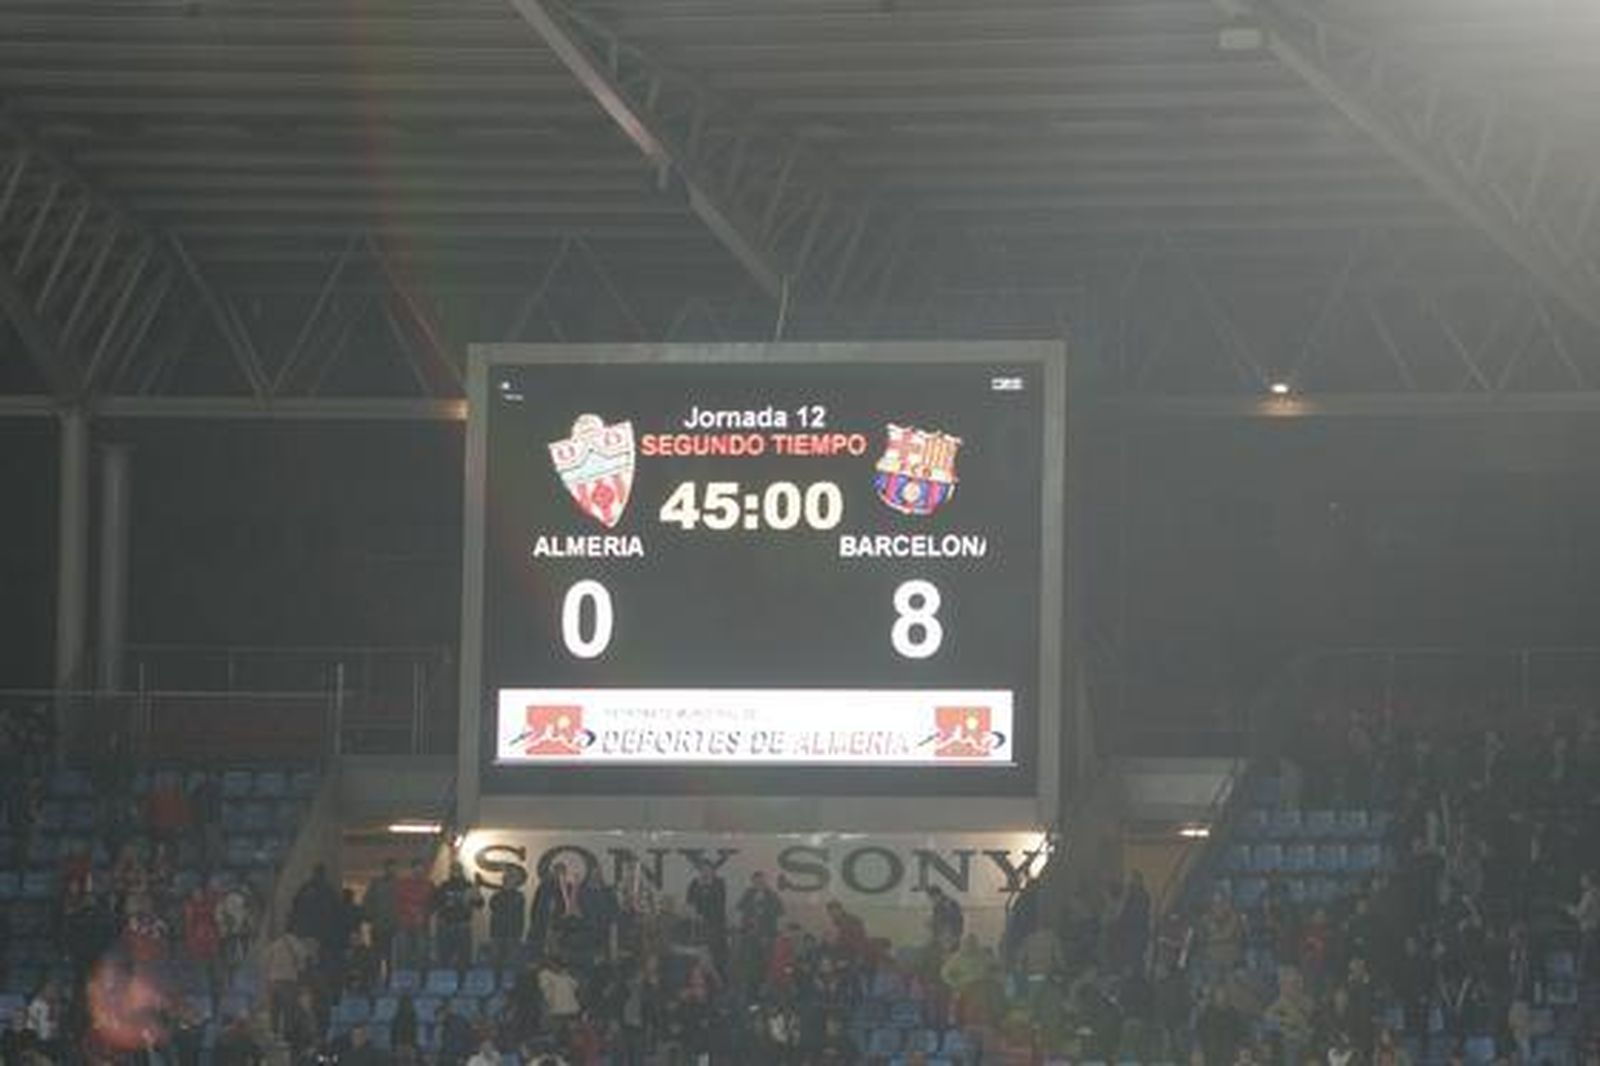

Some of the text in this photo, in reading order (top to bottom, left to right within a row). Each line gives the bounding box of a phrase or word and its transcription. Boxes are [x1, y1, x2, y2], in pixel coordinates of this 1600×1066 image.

[683, 405, 826, 429] Jornada 12
[640, 433, 868, 456] SEGUNDO TIEMPO
[659, 480, 844, 531] 45:00
[532, 535, 645, 558] ALMERIA
[562, 578, 614, 659] 0
[891, 578, 943, 659] 8
[601, 729, 742, 756] DEPORTES
[749, 729, 786, 756] DE
[475, 845, 1040, 894] SONY SONY
